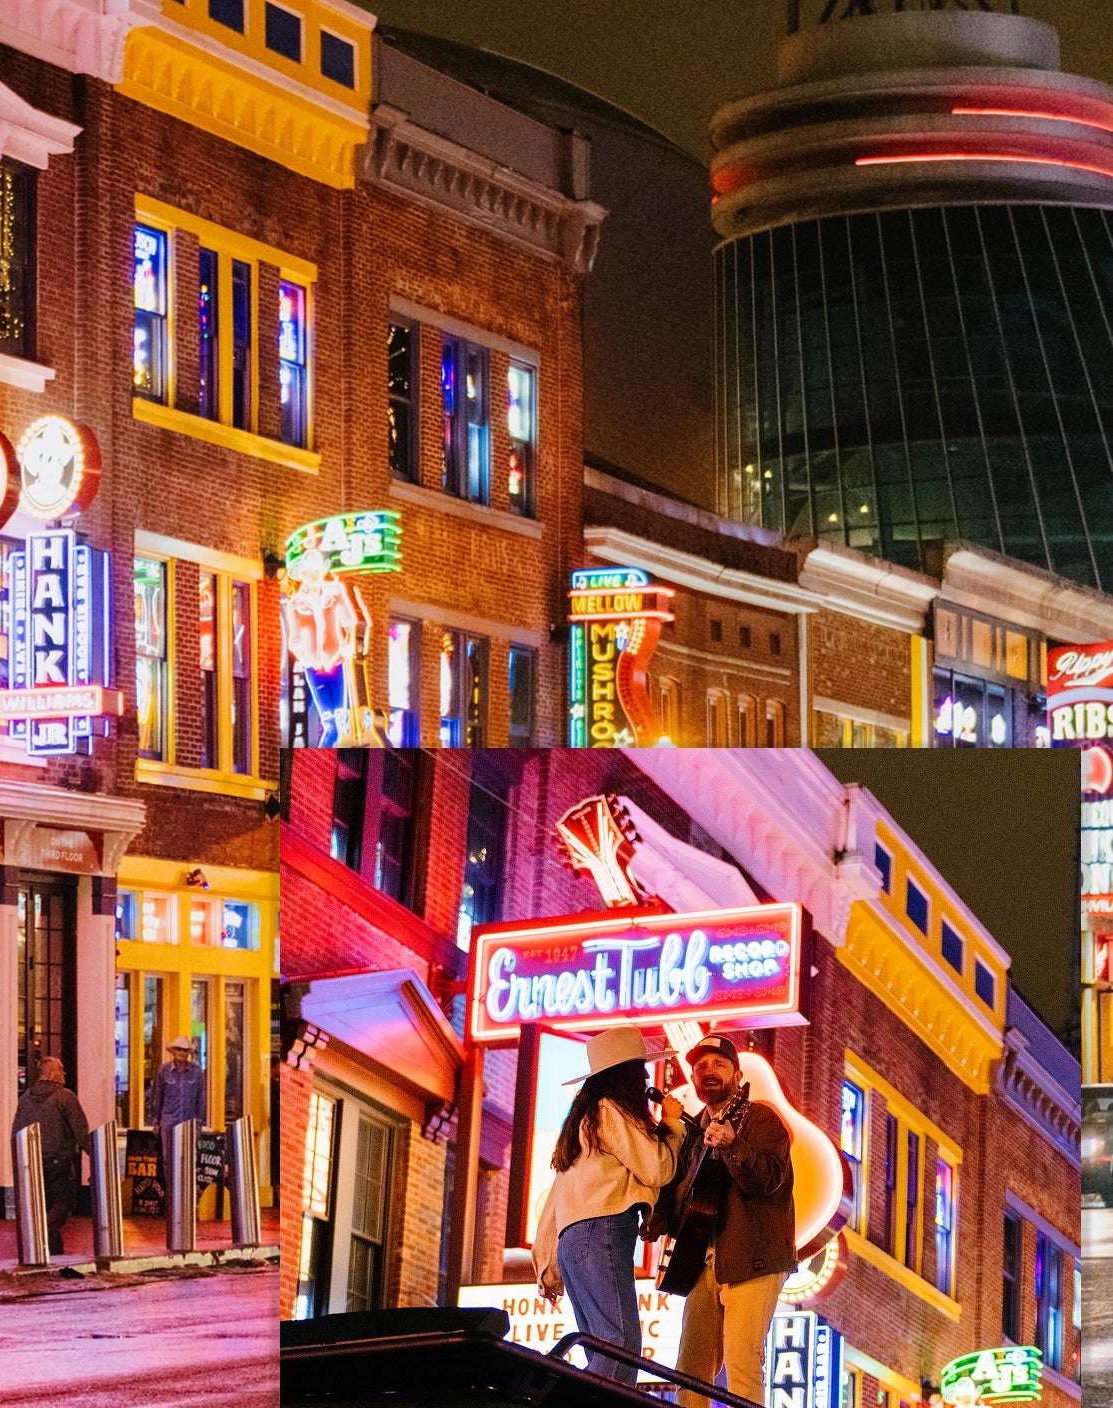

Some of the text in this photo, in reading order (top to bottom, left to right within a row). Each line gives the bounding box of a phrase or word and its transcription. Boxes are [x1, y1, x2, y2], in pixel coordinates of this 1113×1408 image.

[589, 575, 623, 588] LIVE
[33, 536, 66, 684] HANK
[571, 593, 643, 614] MELLOW
[2, 692, 96, 712] WILLIAMS
[32, 722, 68, 747] JR
[60, 851, 84, 864] FLOOR
[709, 940, 791, 964] RECORD
[486, 929, 713, 1024] Ernest Tubb
[722, 958, 779, 981] SHOP
[127, 1162, 158, 1177] BAR
